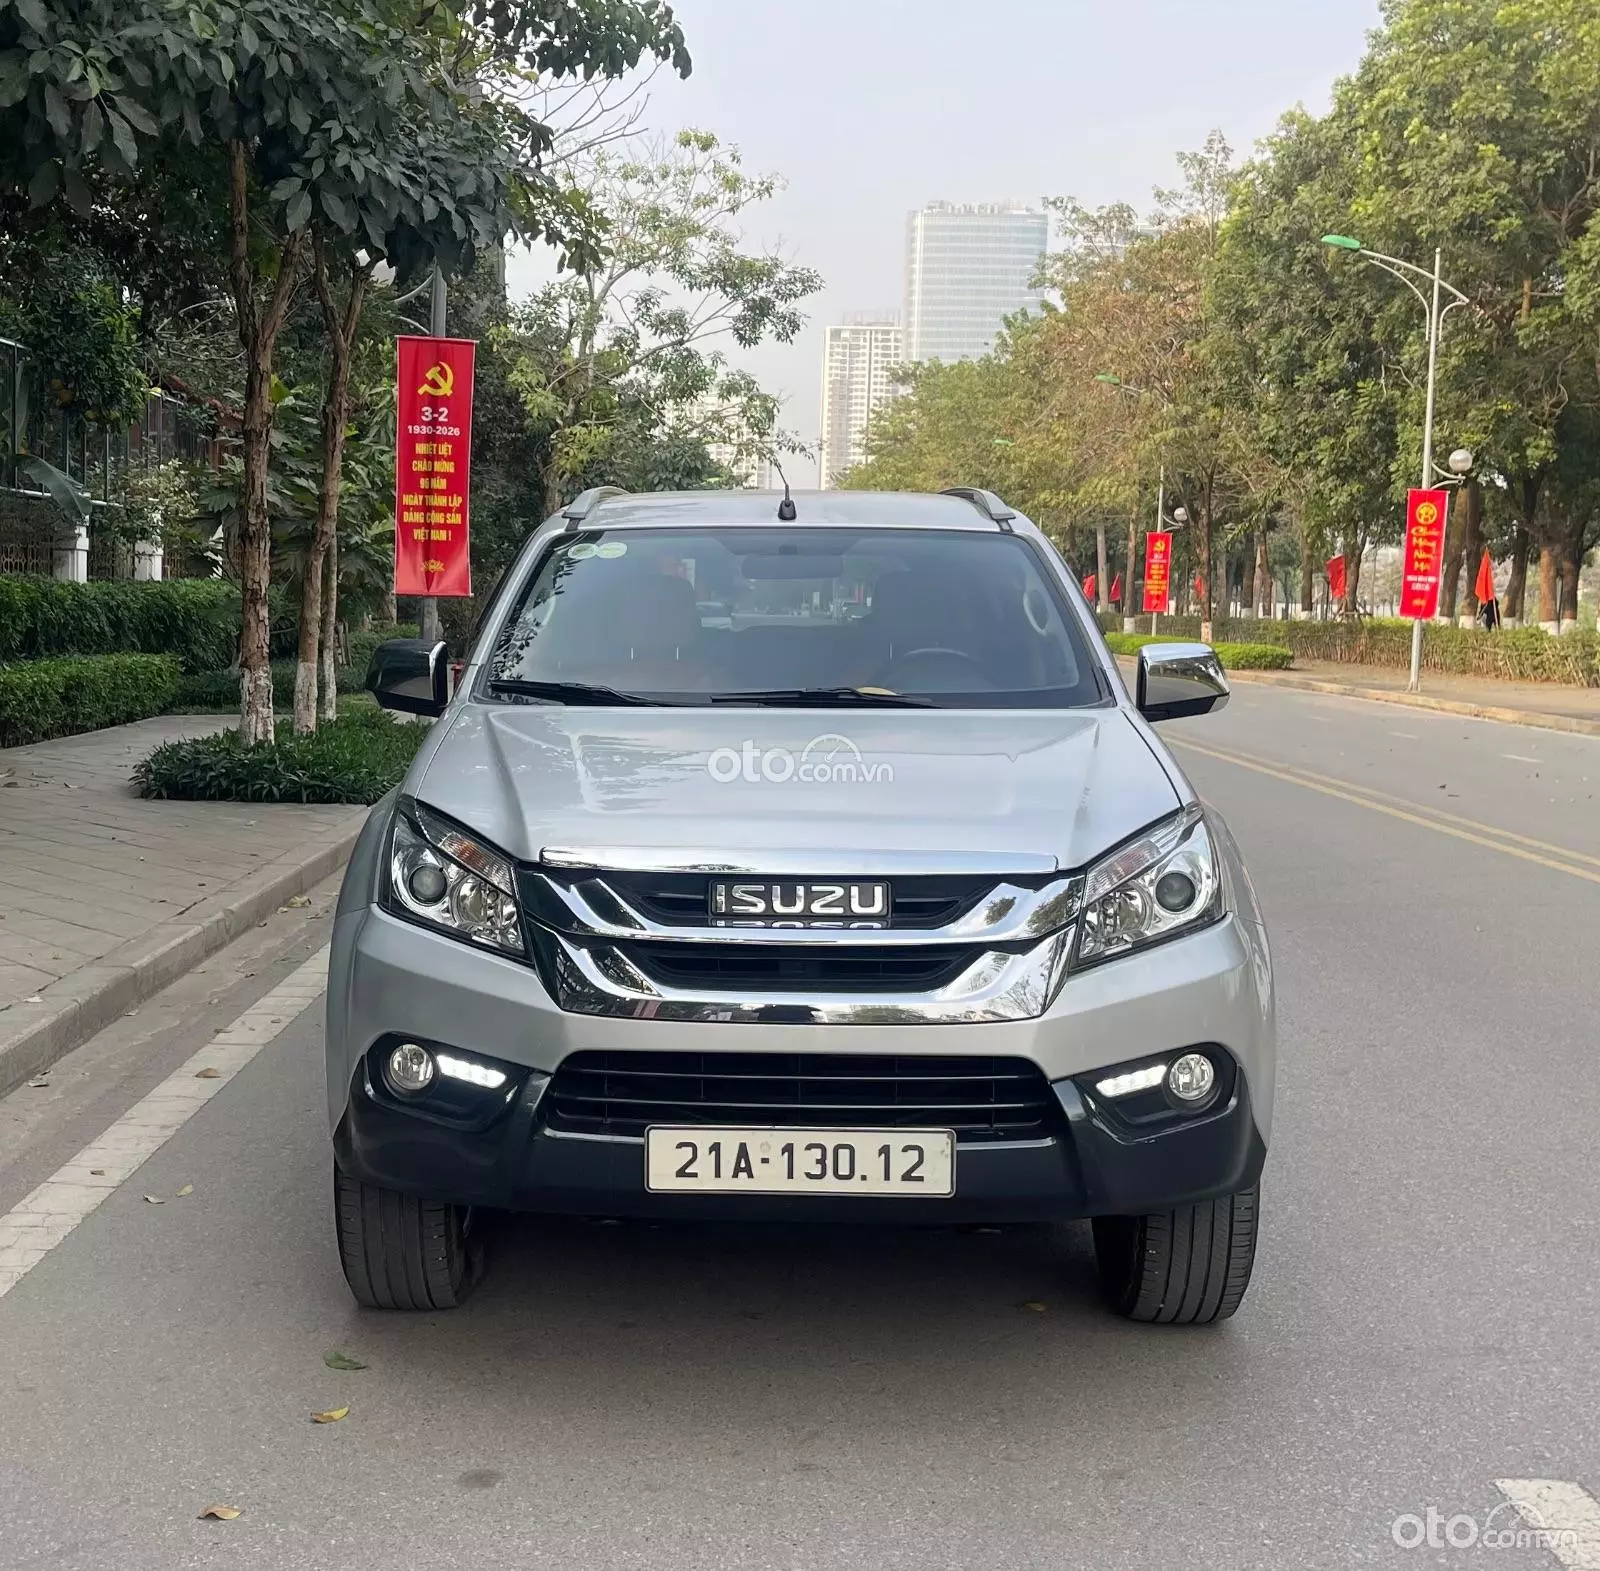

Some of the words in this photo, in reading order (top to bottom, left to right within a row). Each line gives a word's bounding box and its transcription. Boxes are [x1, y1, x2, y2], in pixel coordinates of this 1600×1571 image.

[421, 406, 448, 422] 3-2
[408, 426, 460, 436] 1930-2026
[412, 460, 432, 472] CHÀO
[716, 884, 884, 914] ISUZU
[675, 1141, 926, 1183] 21A-130.12
